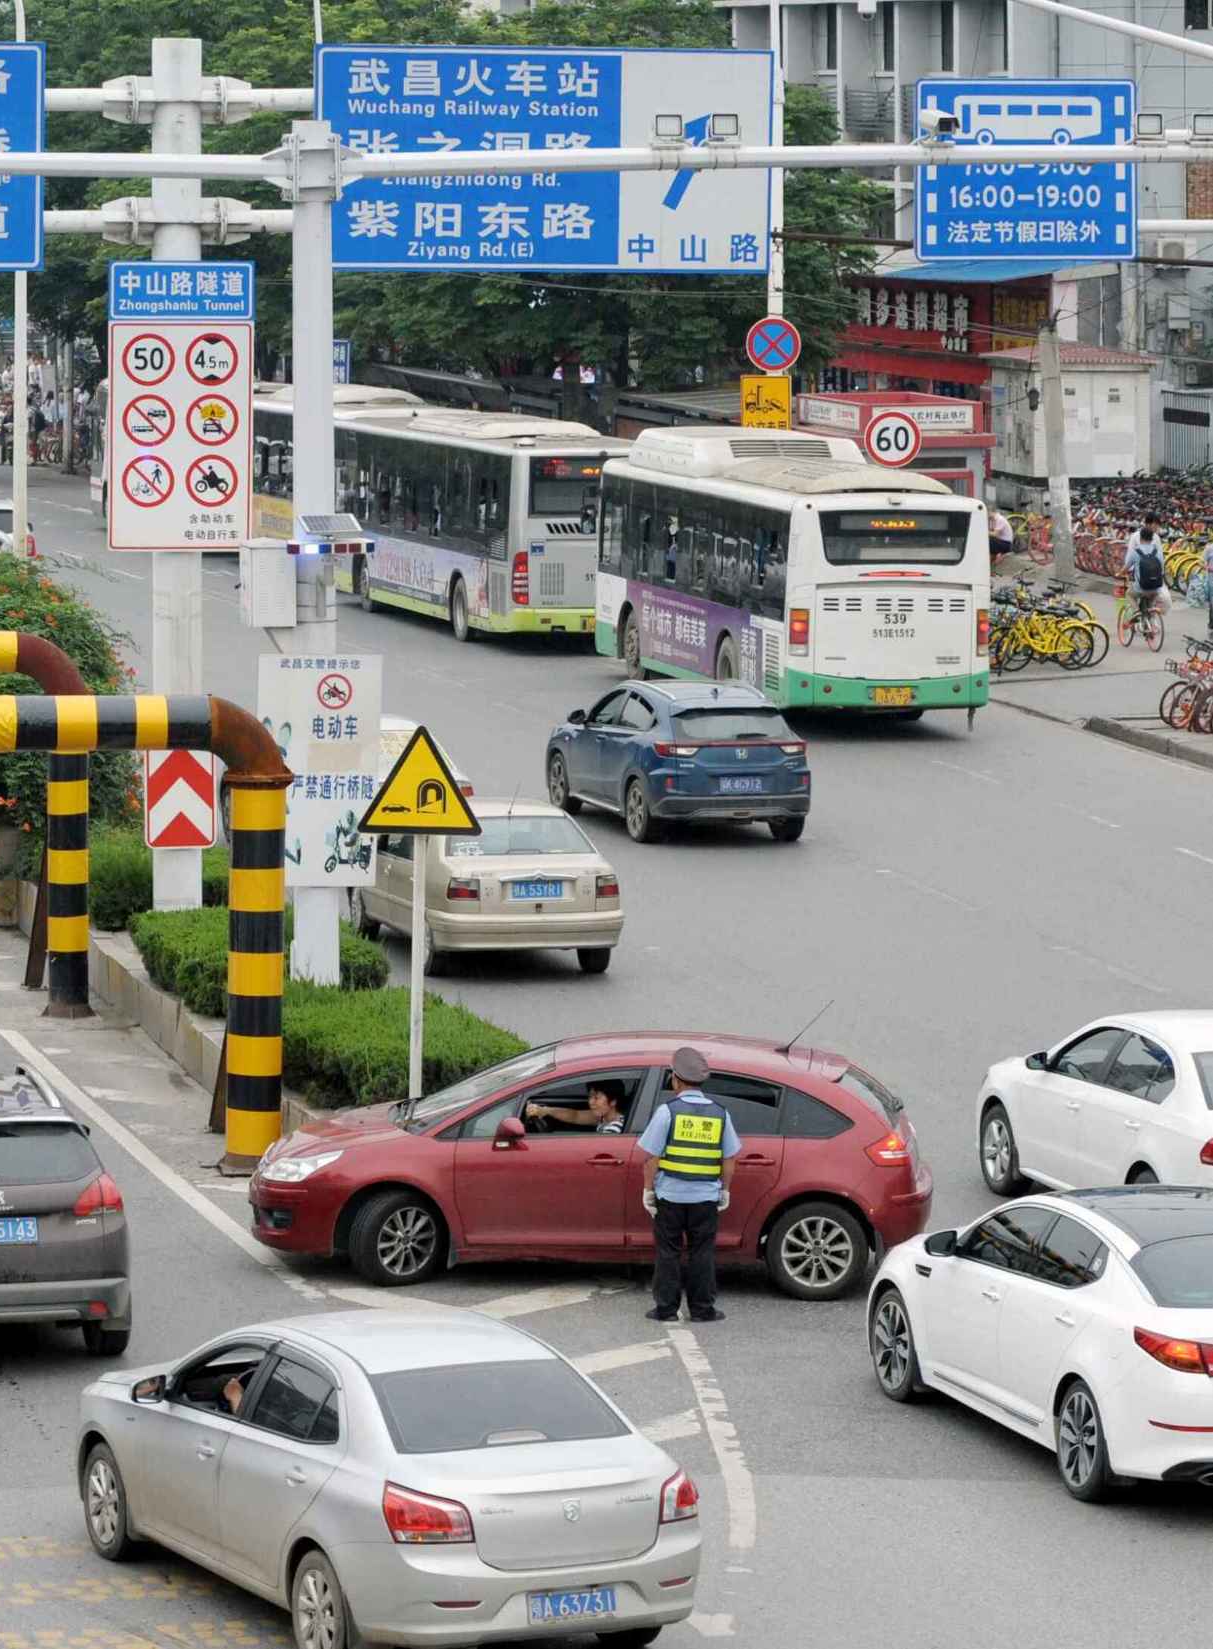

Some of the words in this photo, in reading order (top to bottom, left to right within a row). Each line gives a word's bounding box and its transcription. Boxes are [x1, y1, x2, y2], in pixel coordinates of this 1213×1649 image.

[348, 59, 600, 98] 武昌火车站
[348, 100, 435, 117] Wuchang
[444, 101, 520, 120] Railway
[529, 101, 599, 117] Station
[382, 174, 522, 190] Zhangzhidong
[533, 172, 561, 188] Rd.
[949, 185, 1101, 208] 16:00-19:00
[348, 201, 594, 240] 紫阳东路
[947, 221, 1101, 244] 法定节假日除外
[407, 242, 471, 261] Ziyang
[627, 234, 760, 263] 中山路
[119, 270, 244, 296] 中山路隧道
[118, 299, 199, 312] Zhongshanlu
[204, 300, 245, 312] Tunnel
[133, 347, 164, 371] 50
[876, 426, 910, 452] 60
[883, 613, 908, 625] 539
[312, 714, 358, 740] 电动车
[291, 775, 375, 800] 严禁通行桥隧
